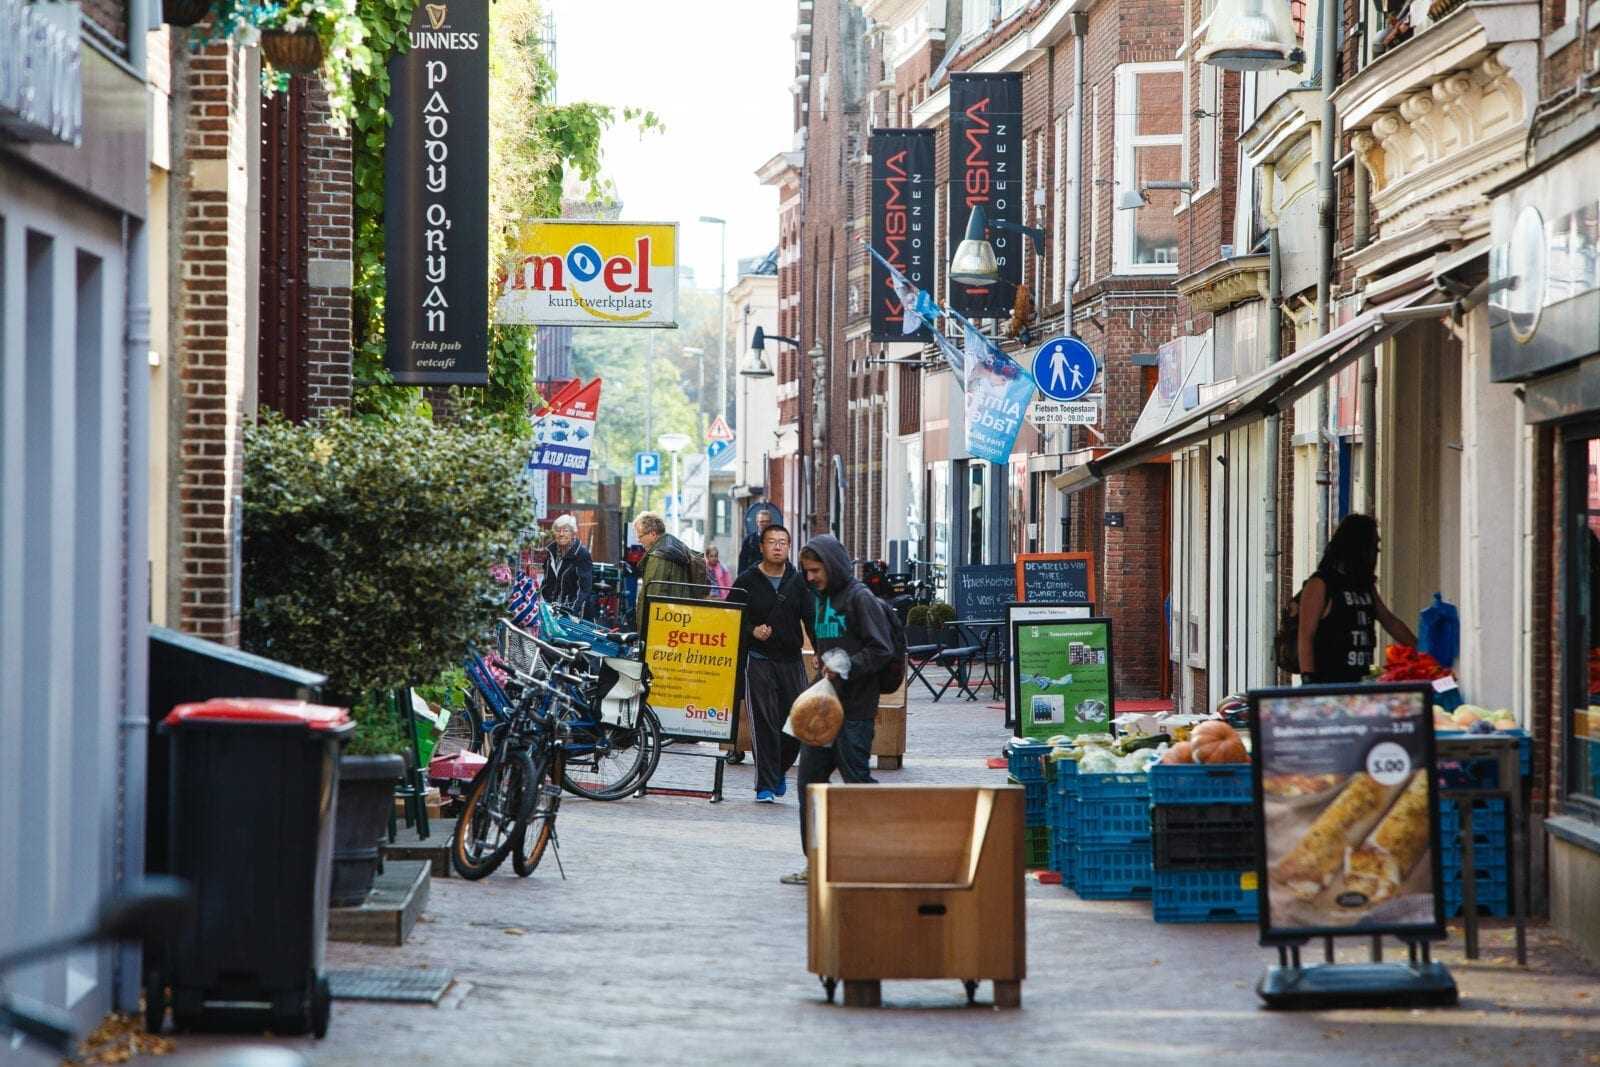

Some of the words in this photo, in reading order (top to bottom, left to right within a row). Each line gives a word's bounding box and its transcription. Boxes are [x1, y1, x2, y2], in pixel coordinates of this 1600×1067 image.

[408, 32, 480, 50] UINNESS
[911, 173, 923, 282] CHOENEN
[548, 295, 653, 312] kunstwerkplaats
[410, 341, 438, 350] Irish
[438, 341, 462, 352] pub
[1035, 404, 1058, 413] Fietsen
[1060, 404, 1095, 414] Toegestaan
[1046, 414, 1063, 422] 21.00
[641, 455, 655, 474] P
[655, 607, 692, 628] Loop
[667, 629, 728, 648] gerust
[1351, 630, 1370, 646] TH
[652, 649, 682, 662] even
[686, 648, 733, 668] binnen
[685, 704, 729, 722] Smoel
